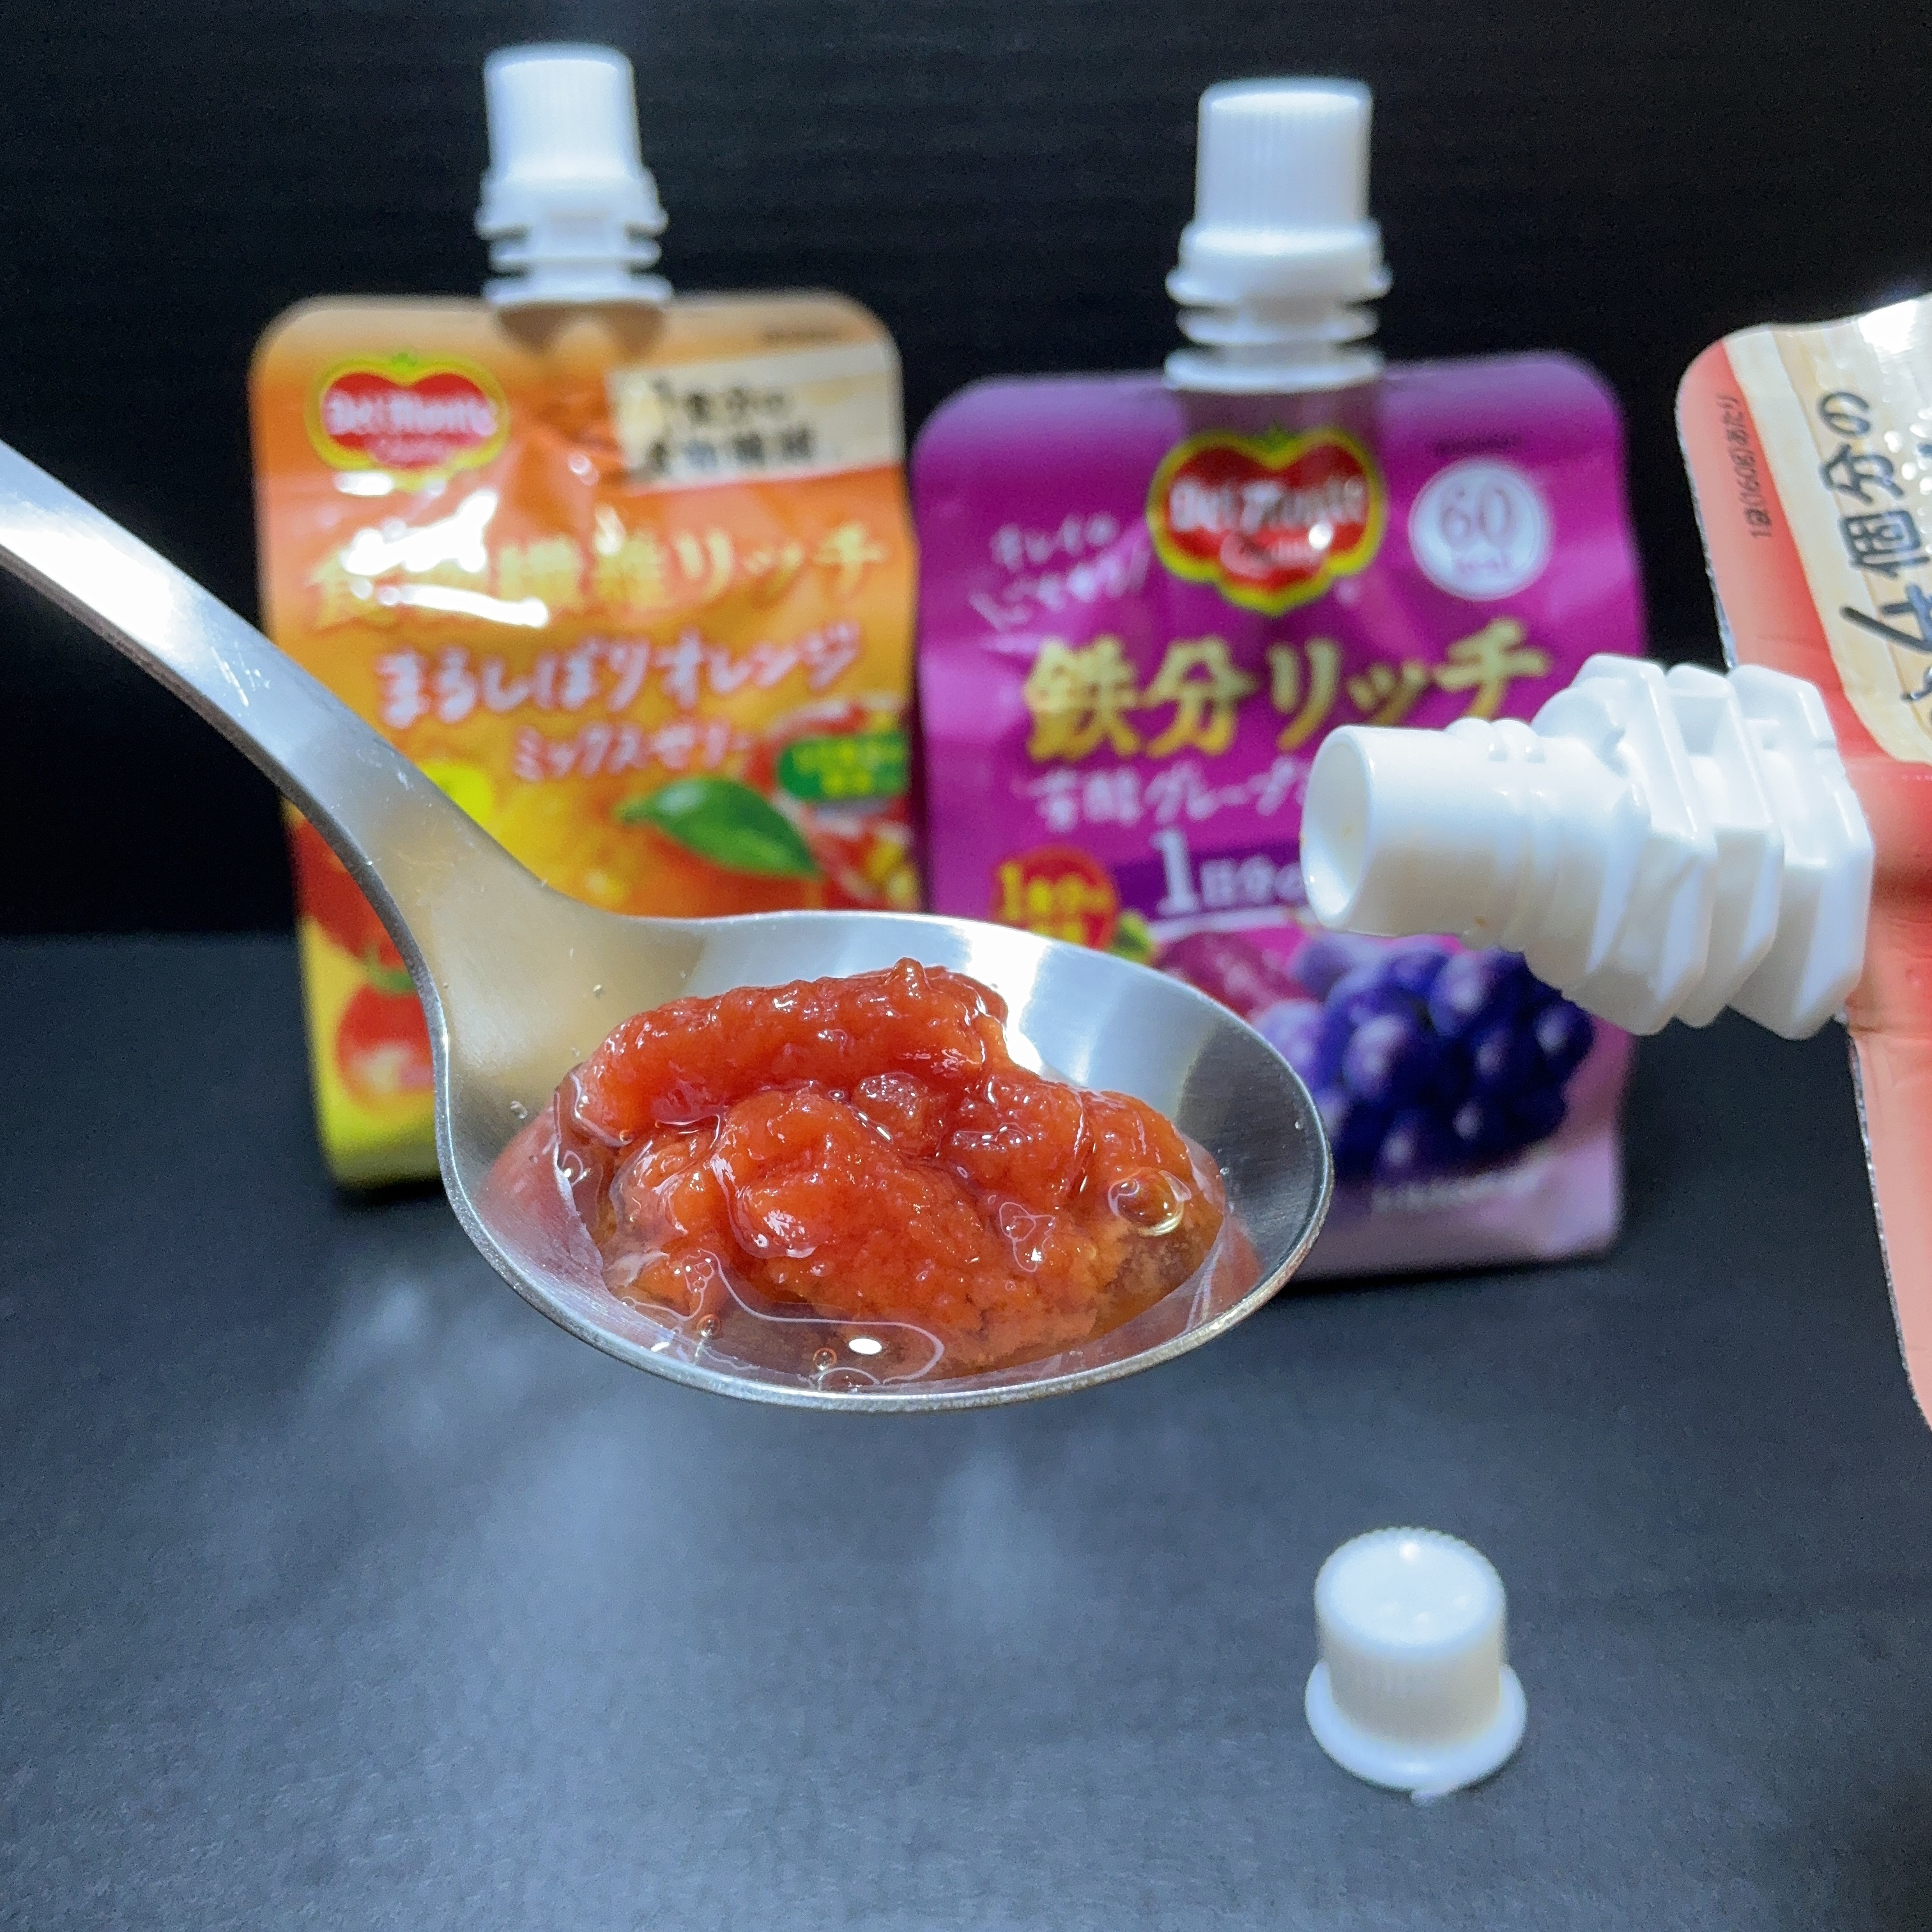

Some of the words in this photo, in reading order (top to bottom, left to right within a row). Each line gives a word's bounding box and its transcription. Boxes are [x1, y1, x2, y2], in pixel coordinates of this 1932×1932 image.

[1438, 480, 1521, 547] 60
[1817, 390, 1932, 703] 4個分の
[1024, 617, 1550, 763] 鉄分リッチ
